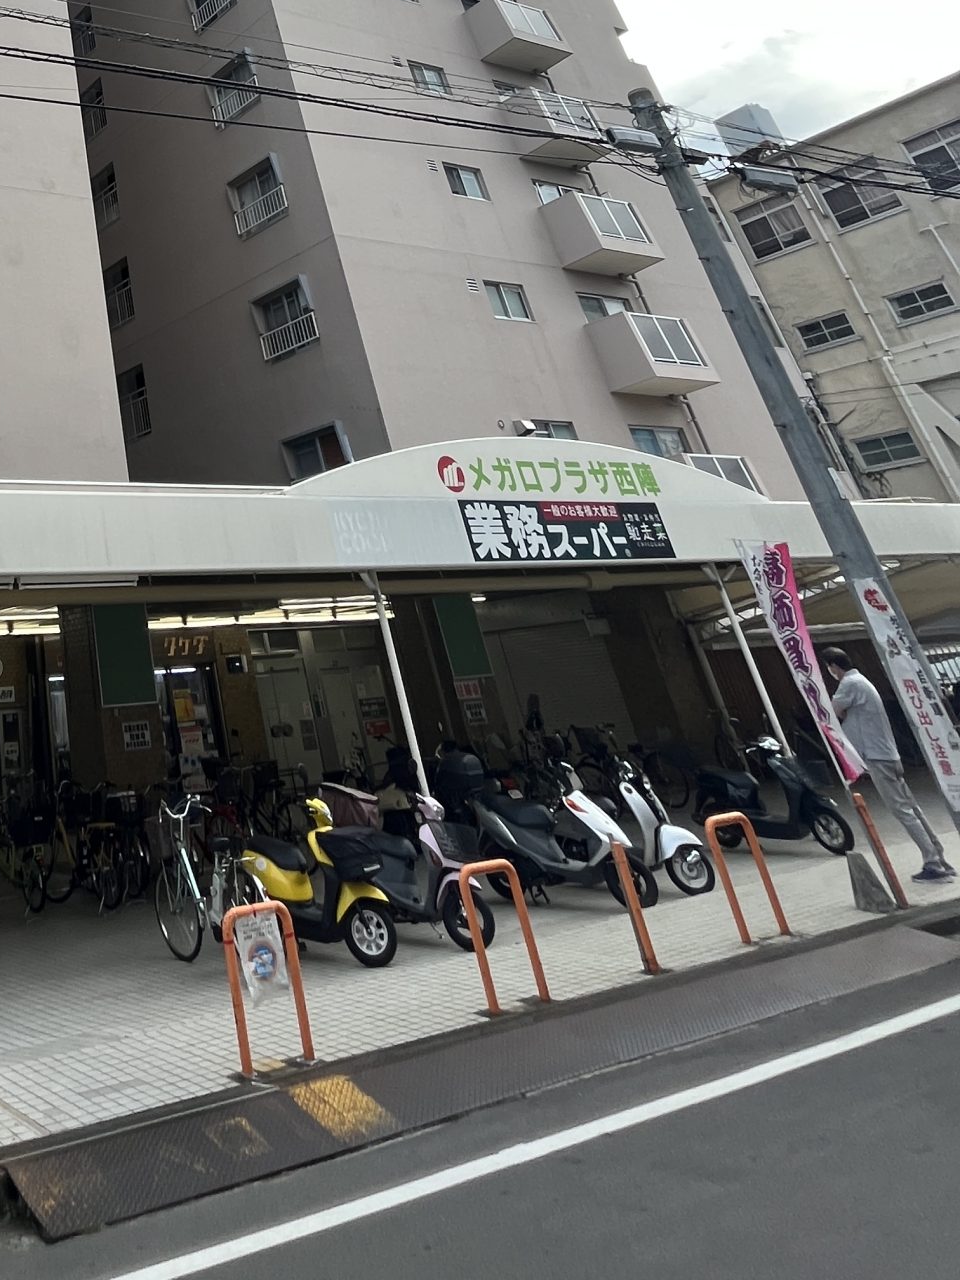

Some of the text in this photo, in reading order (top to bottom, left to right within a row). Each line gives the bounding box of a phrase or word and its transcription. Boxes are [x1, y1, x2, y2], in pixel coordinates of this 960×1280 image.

[468, 456, 662, 497] メガロプラザ西陣
[464, 502, 629, 559] 業務スーパー
[543, 504, 619, 518] 一般のお客様大歓迎
[625, 522, 668, 541] 馳走菜
[902, 678, 956, 776] 飛び出し注意
